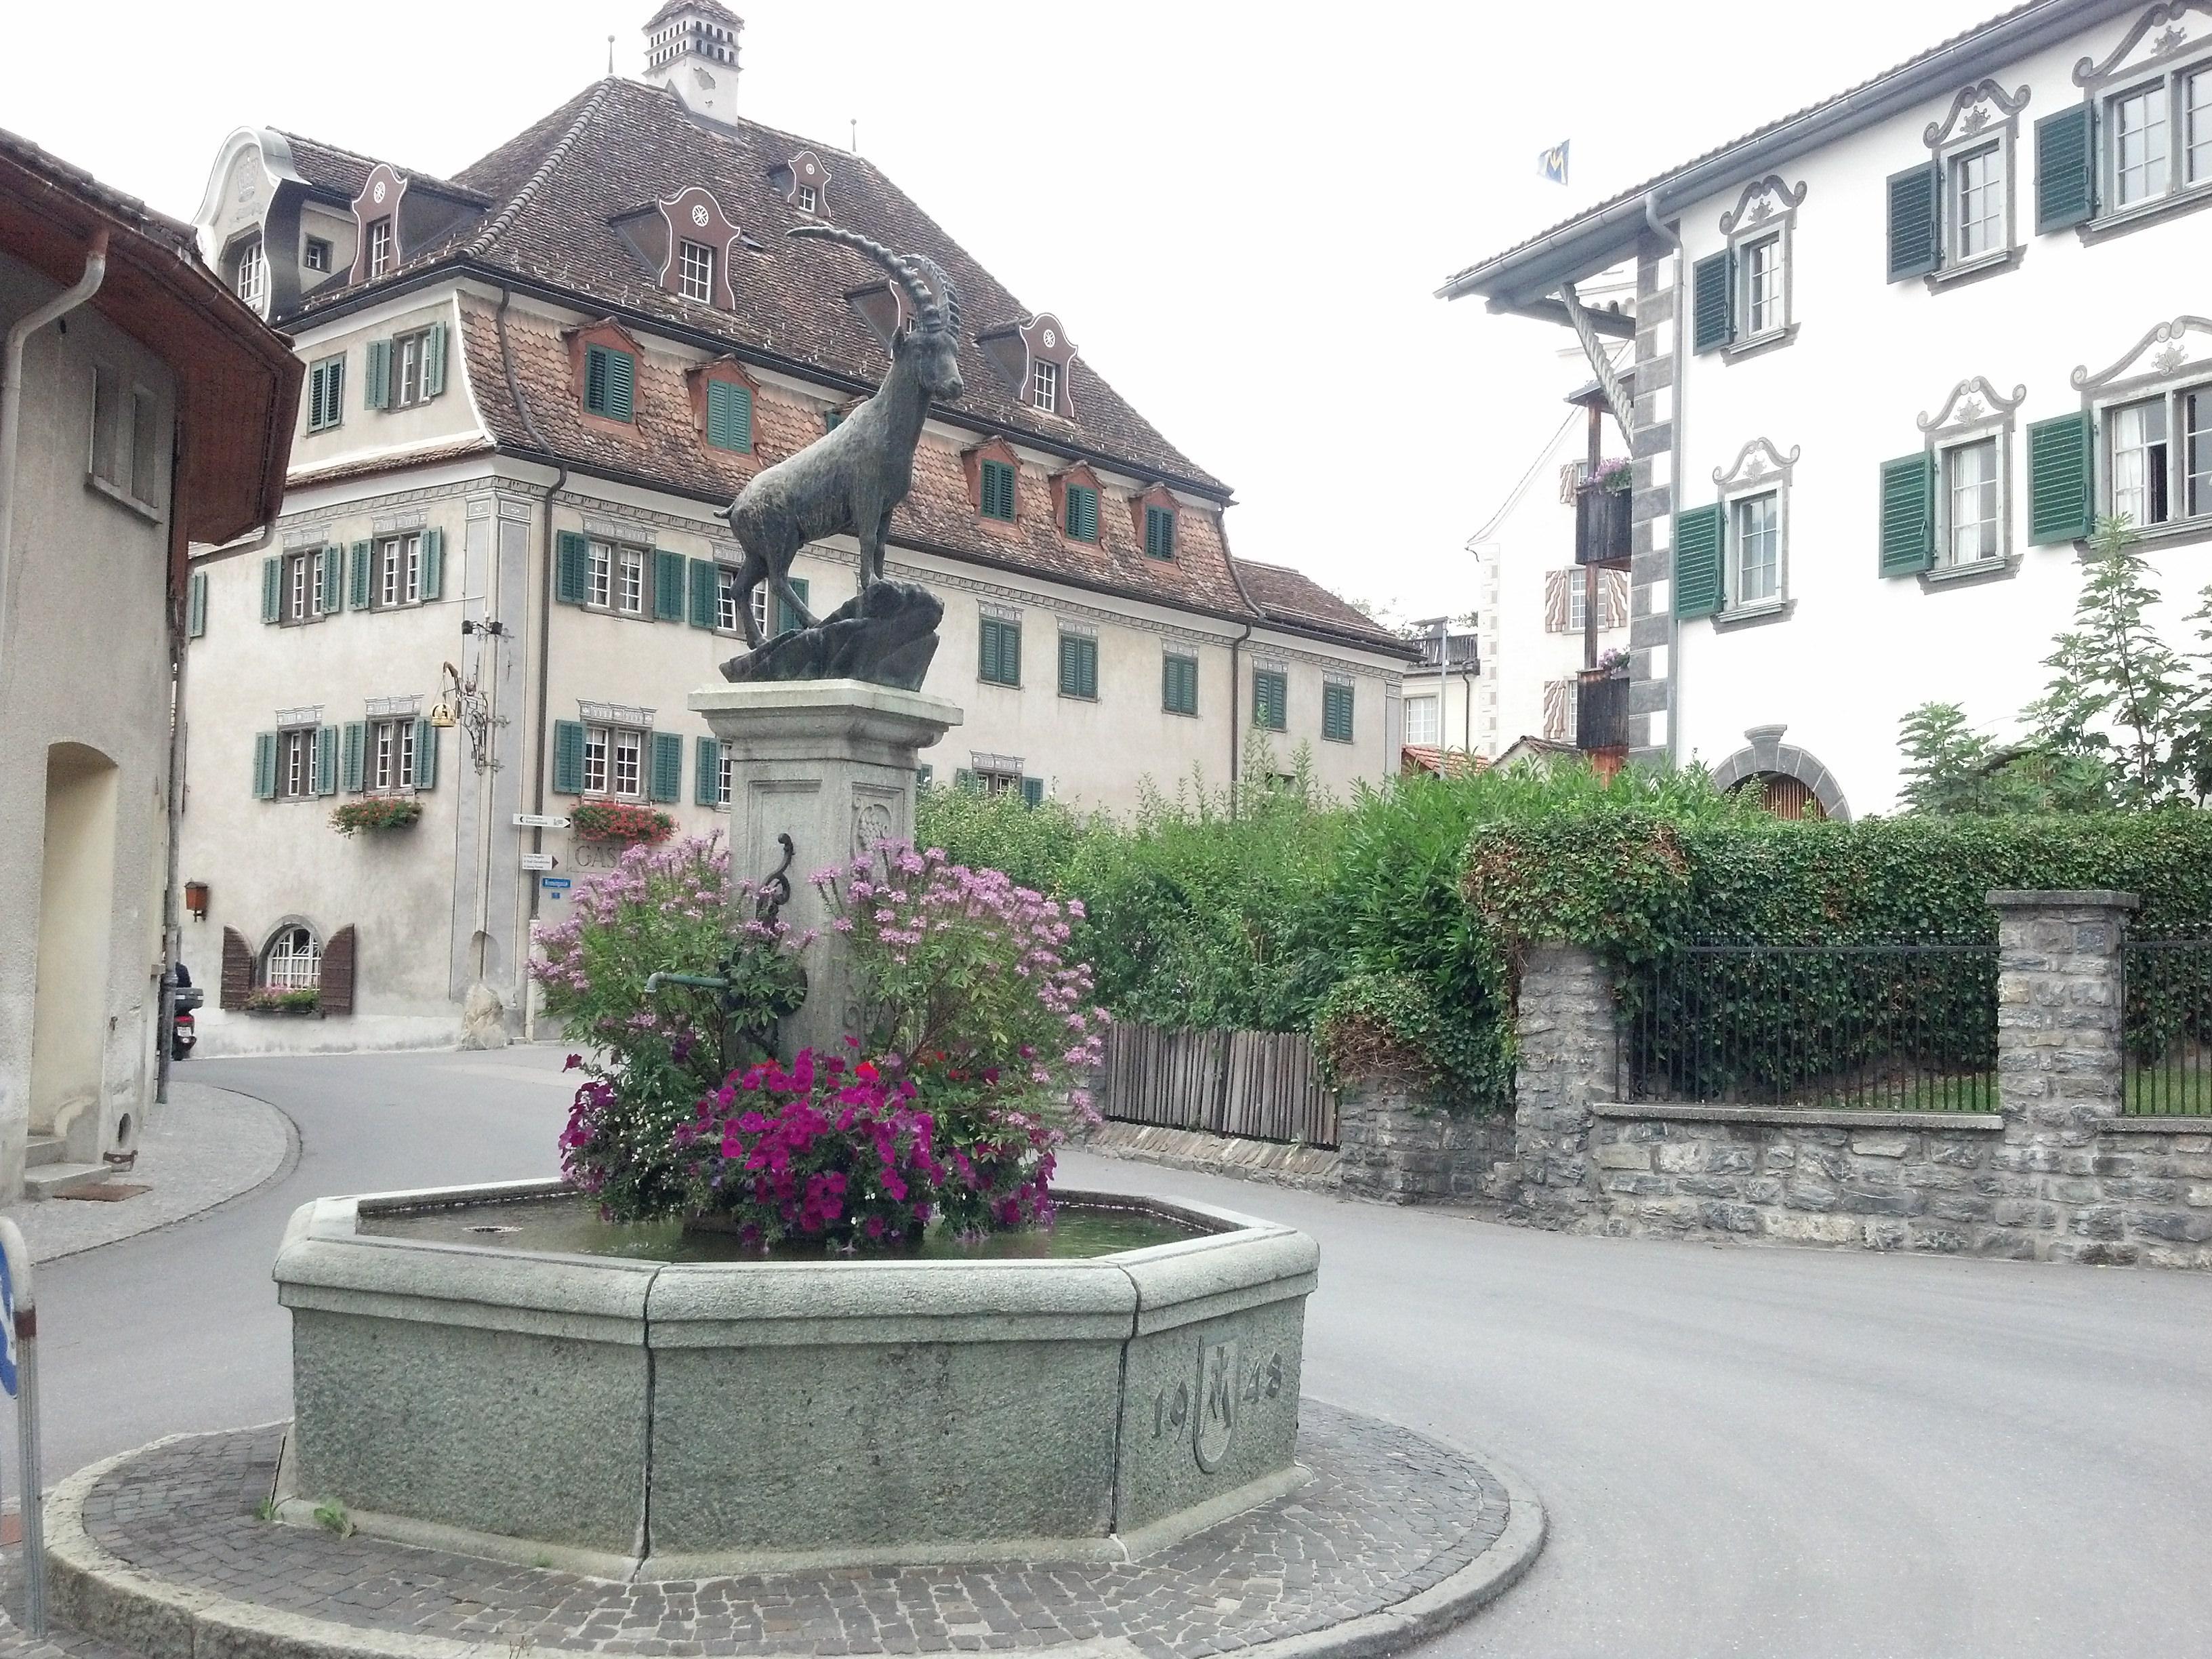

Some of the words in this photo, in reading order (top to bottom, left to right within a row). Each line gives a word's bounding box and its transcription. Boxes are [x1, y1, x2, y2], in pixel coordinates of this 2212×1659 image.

[575, 845, 627, 868] GAS
[1151, 1378, 1188, 1443] 19
[1242, 1349, 1282, 1402] 48
